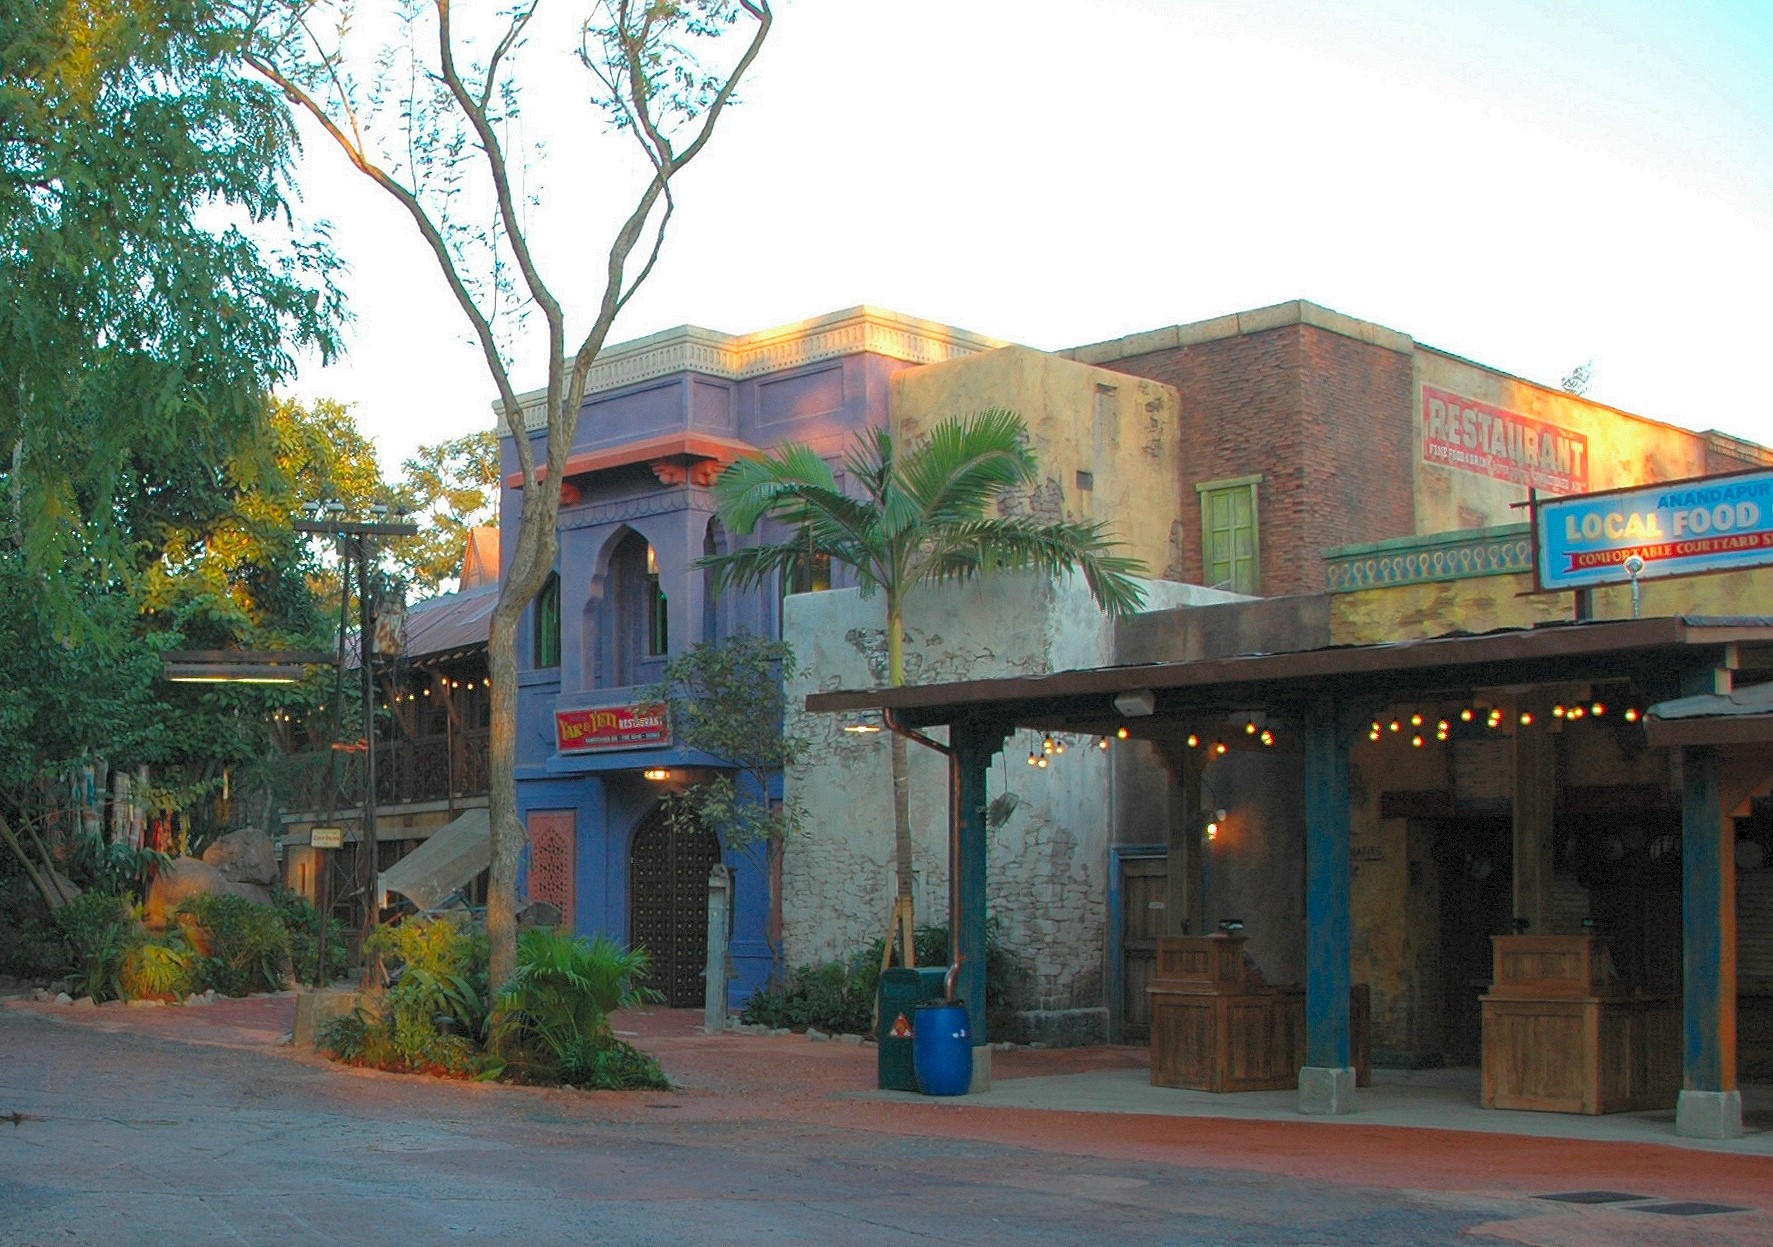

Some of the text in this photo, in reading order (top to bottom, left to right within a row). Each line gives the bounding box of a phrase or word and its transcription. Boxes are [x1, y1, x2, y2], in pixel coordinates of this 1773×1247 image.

[1429, 398, 1584, 477] RESTAURANT
[1657, 482, 1771, 509] ANANDAPUR
[1565, 502, 1760, 541] LOCAL FOOD
[1579, 532, 1773, 566] COMFORTABLE COURTYARD S
[619, 717, 663, 730] RESTRANT
